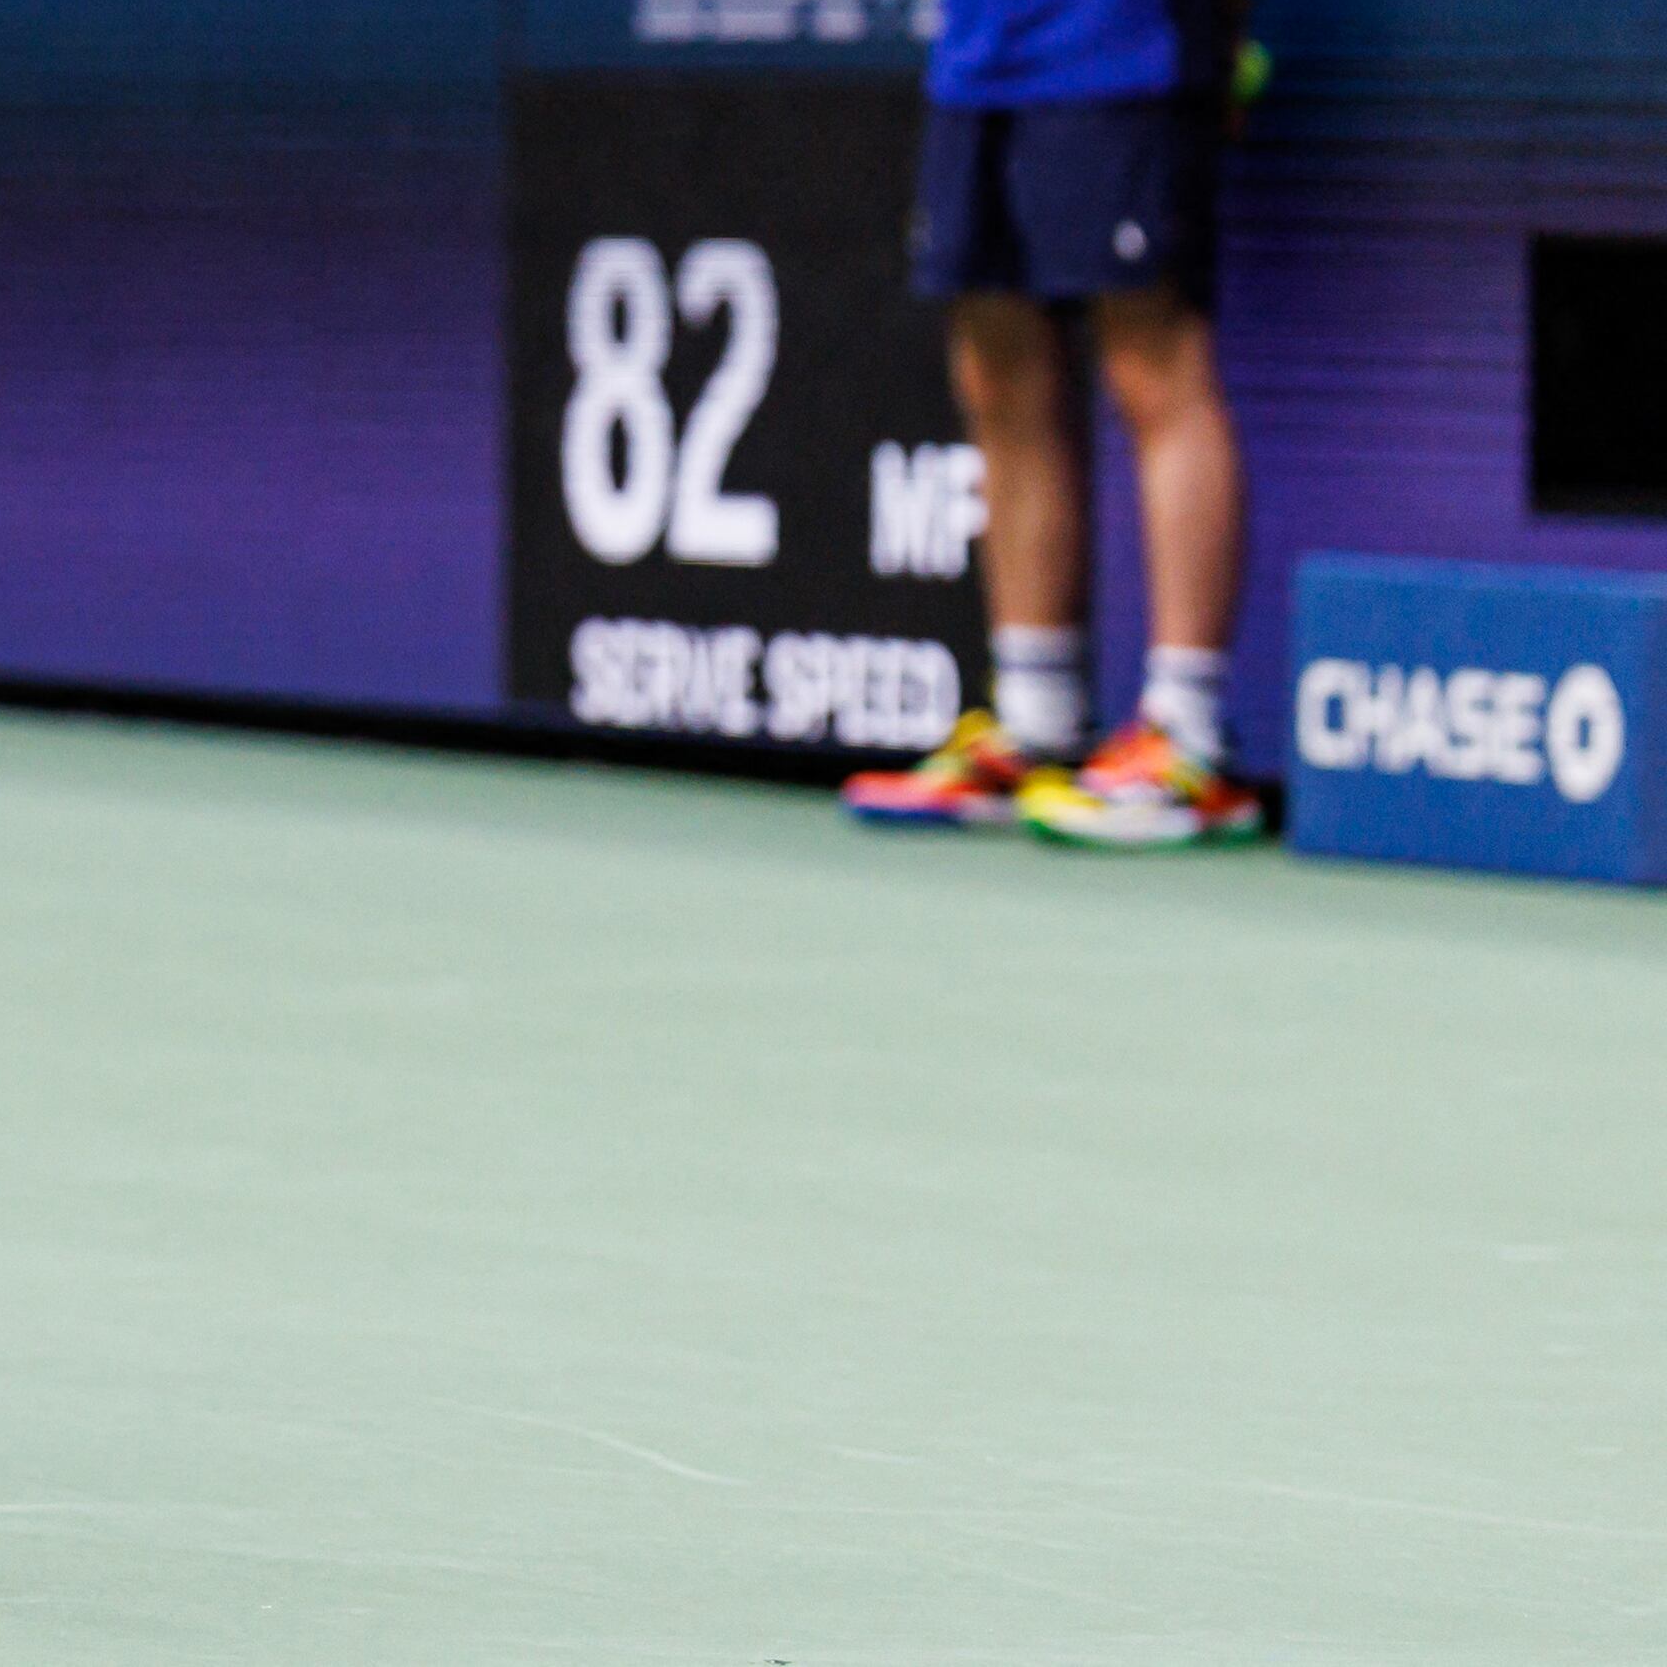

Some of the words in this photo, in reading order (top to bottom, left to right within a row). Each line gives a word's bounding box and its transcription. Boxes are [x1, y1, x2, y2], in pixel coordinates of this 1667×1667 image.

[562, 238, 779, 566] 82
[870, 441, 986, 577] MP
[570, 617, 764, 737] SERVE
[766, 630, 961, 749] SPEED
[1296, 656, 1545, 786] CHASE
